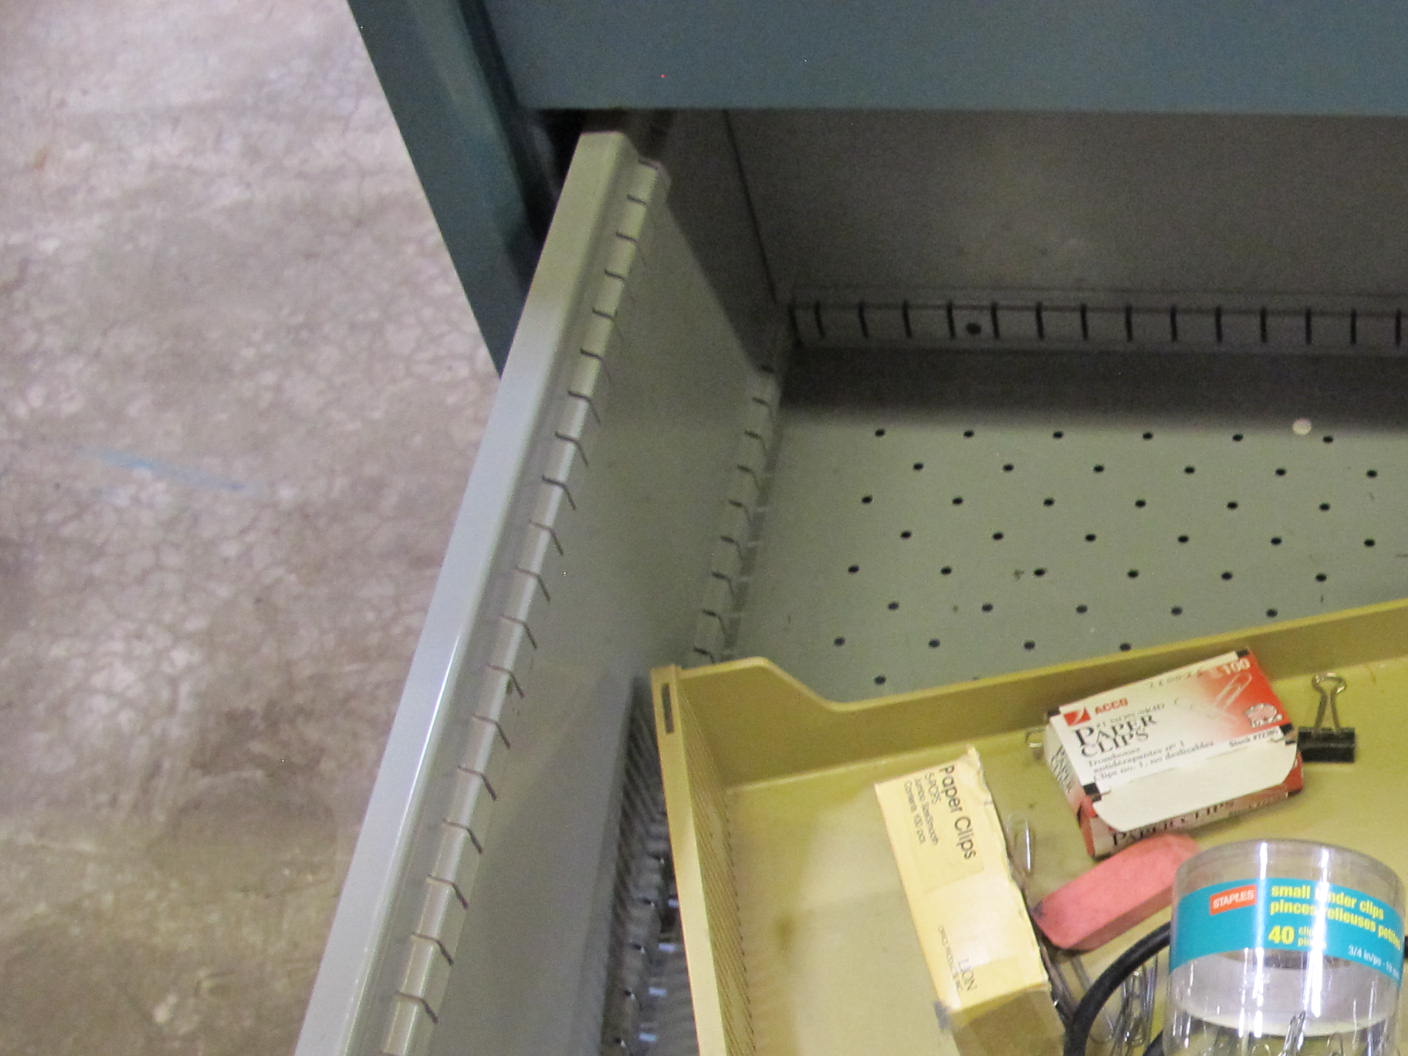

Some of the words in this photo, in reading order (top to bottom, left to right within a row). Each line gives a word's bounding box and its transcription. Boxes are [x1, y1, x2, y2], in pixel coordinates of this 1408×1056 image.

[1094, 697, 1129, 716] ACCO
[1075, 713, 1158, 748] PAPER
[1080, 726, 1151, 759] CLIPS
[939, 764, 964, 814] Paper
[953, 815, 977, 861] Clips
[1211, 889, 1257, 910] STAPLES
[1271, 885, 1311, 900] small
[1360, 898, 1385, 920] clips
[1268, 925, 1296, 945] 40
